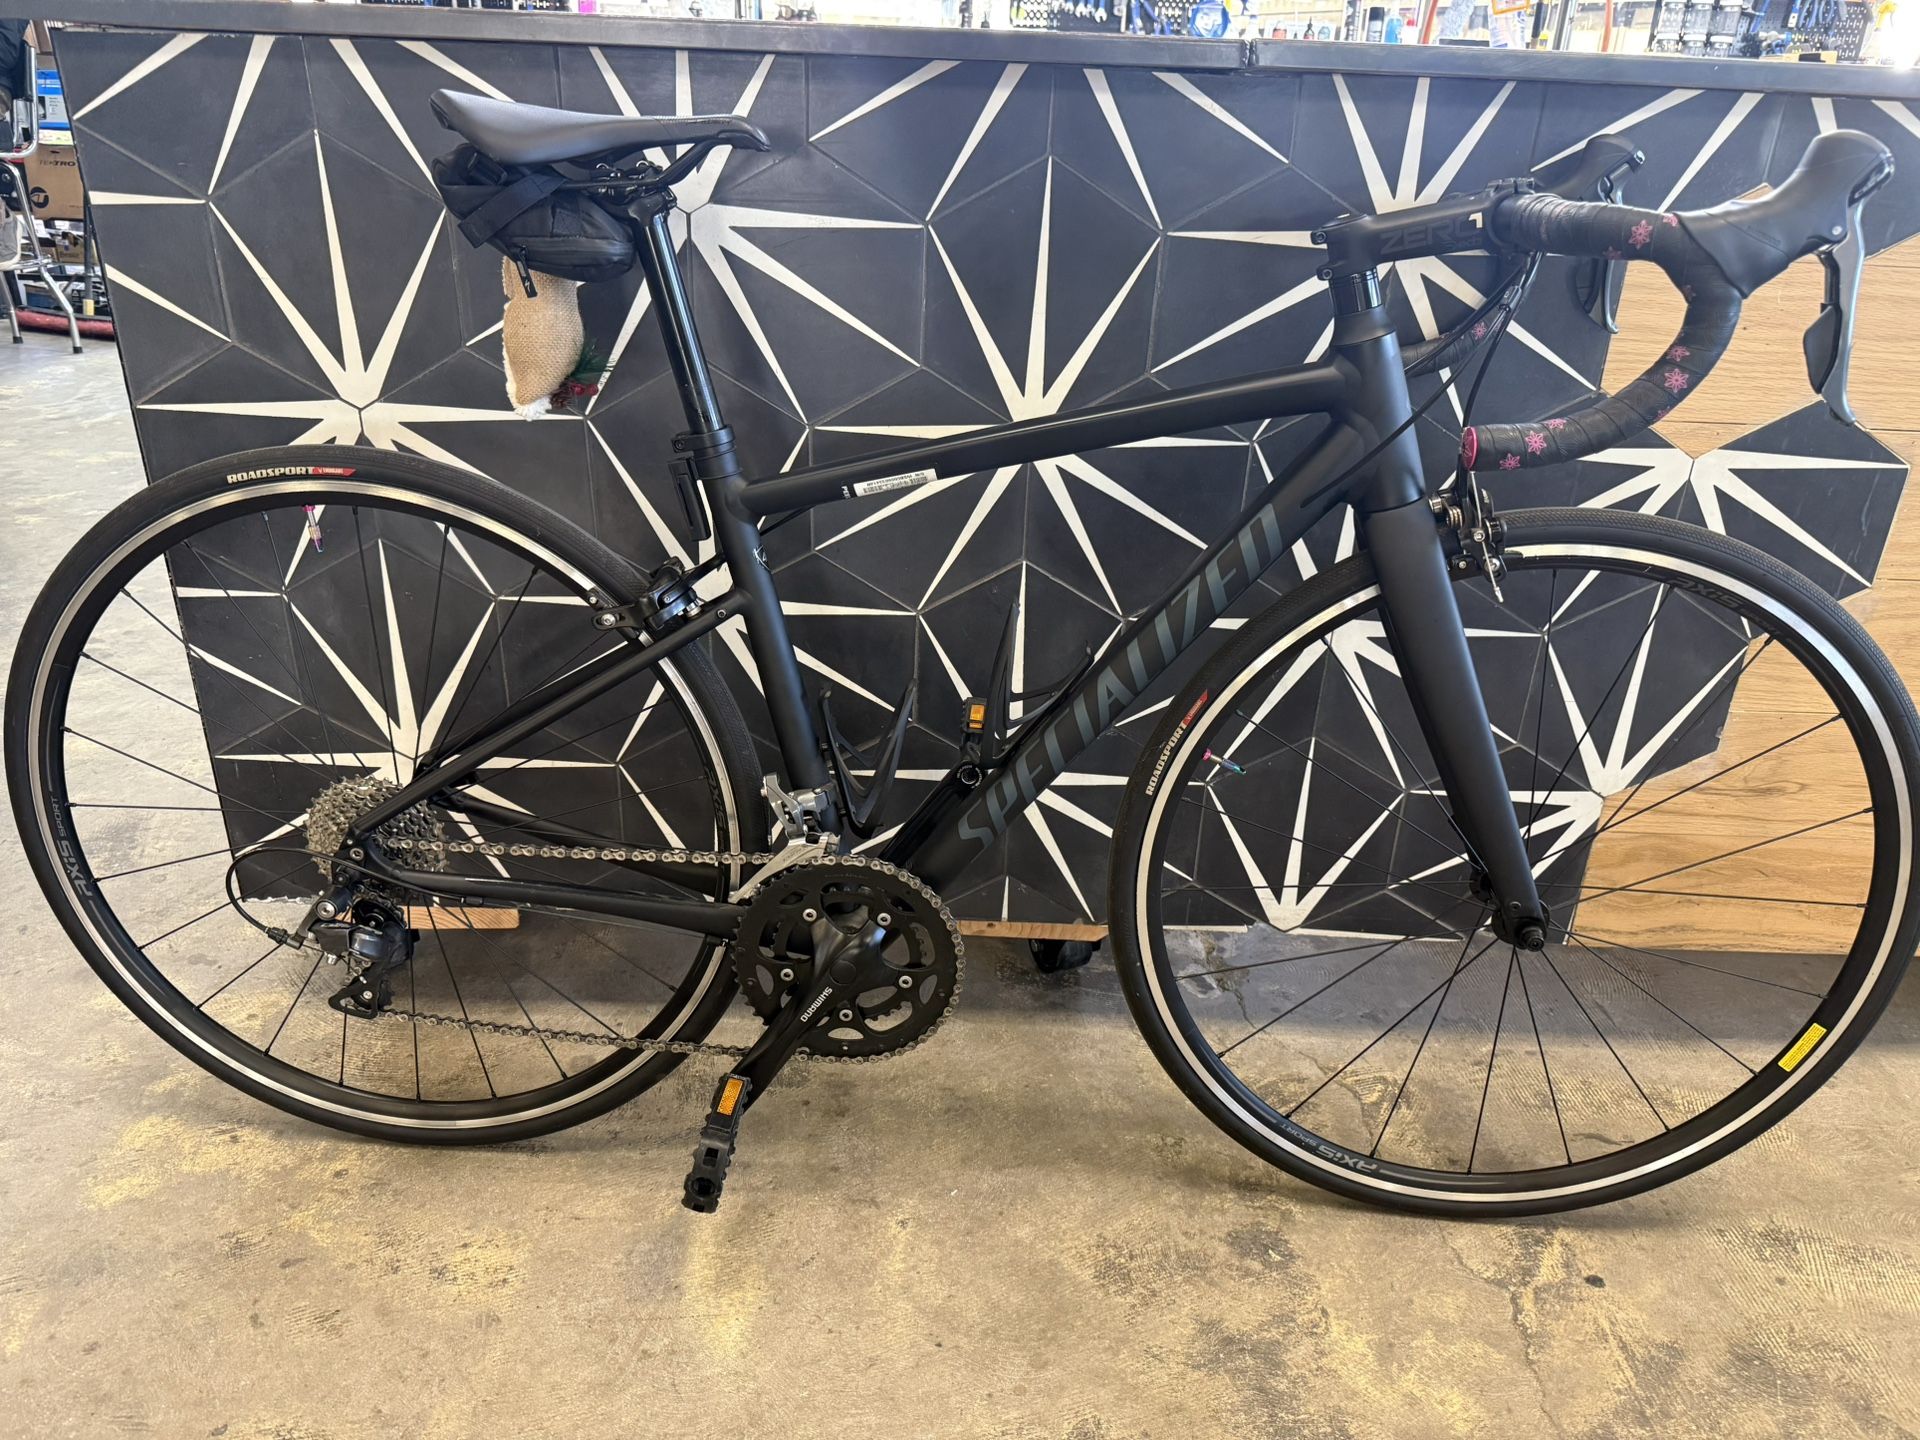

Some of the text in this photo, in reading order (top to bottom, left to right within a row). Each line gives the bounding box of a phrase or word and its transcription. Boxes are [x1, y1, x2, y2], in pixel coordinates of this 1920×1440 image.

[226, 466, 315, 484] ROADSPORT
[957, 503, 1284, 865] SPECIALIZED
[1145, 720, 1187, 796] ROADSPORT
[51, 795, 67, 838] SPORT
[800, 986, 833, 1023] SHIMANO
[1280, 1123, 1318, 1147] SPORT
